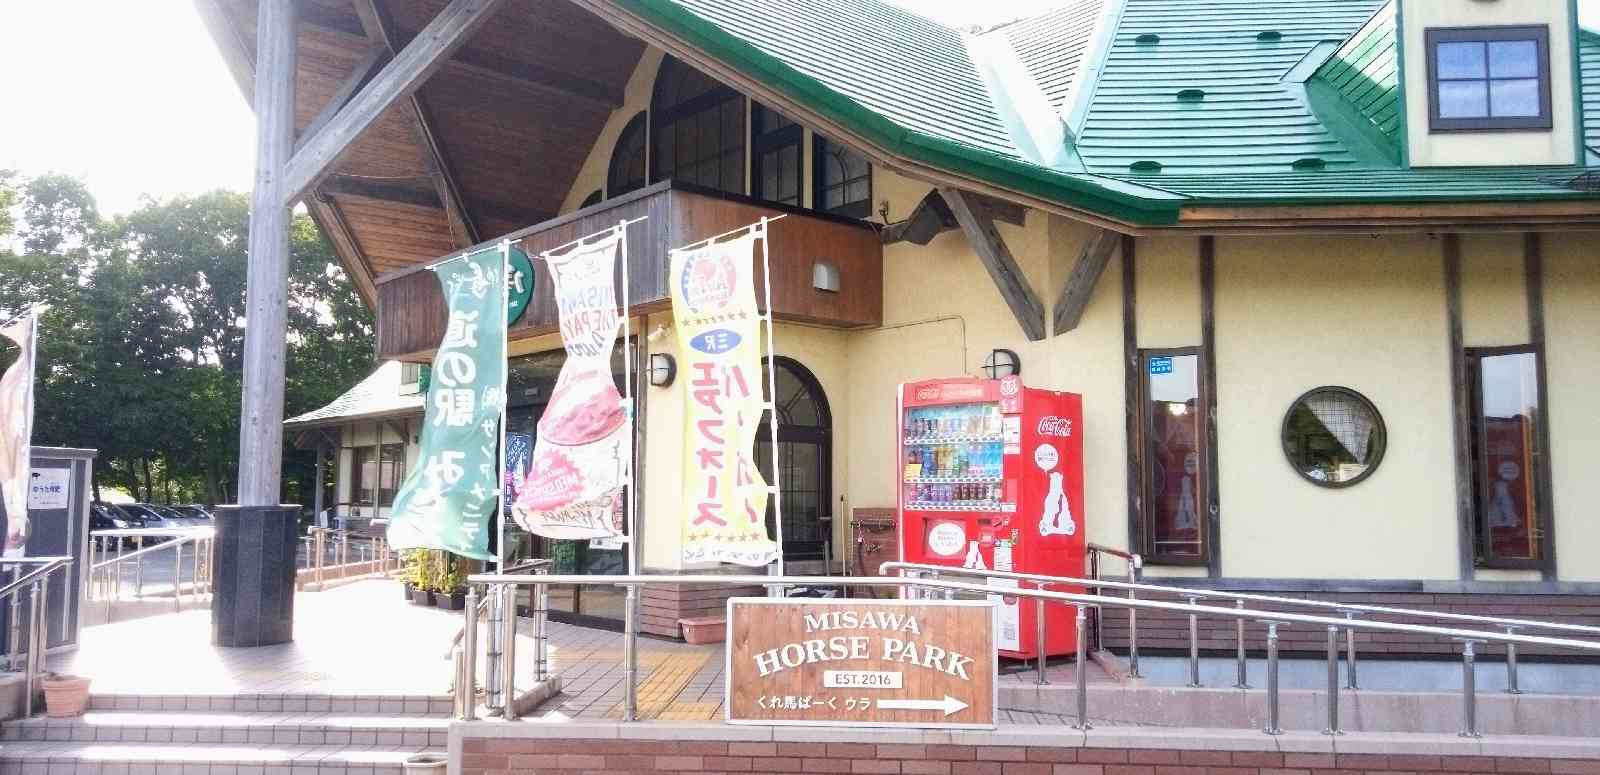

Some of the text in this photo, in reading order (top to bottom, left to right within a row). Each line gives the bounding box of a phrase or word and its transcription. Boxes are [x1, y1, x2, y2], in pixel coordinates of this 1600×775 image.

[1038, 416, 1072, 437] Coca-Cola
[804, 611, 921, 635] MISAWA
[753, 636, 976, 681] HORSE PARK
[835, 673, 892, 686] EST.2016
[845, 696, 872, 711] ウラ
